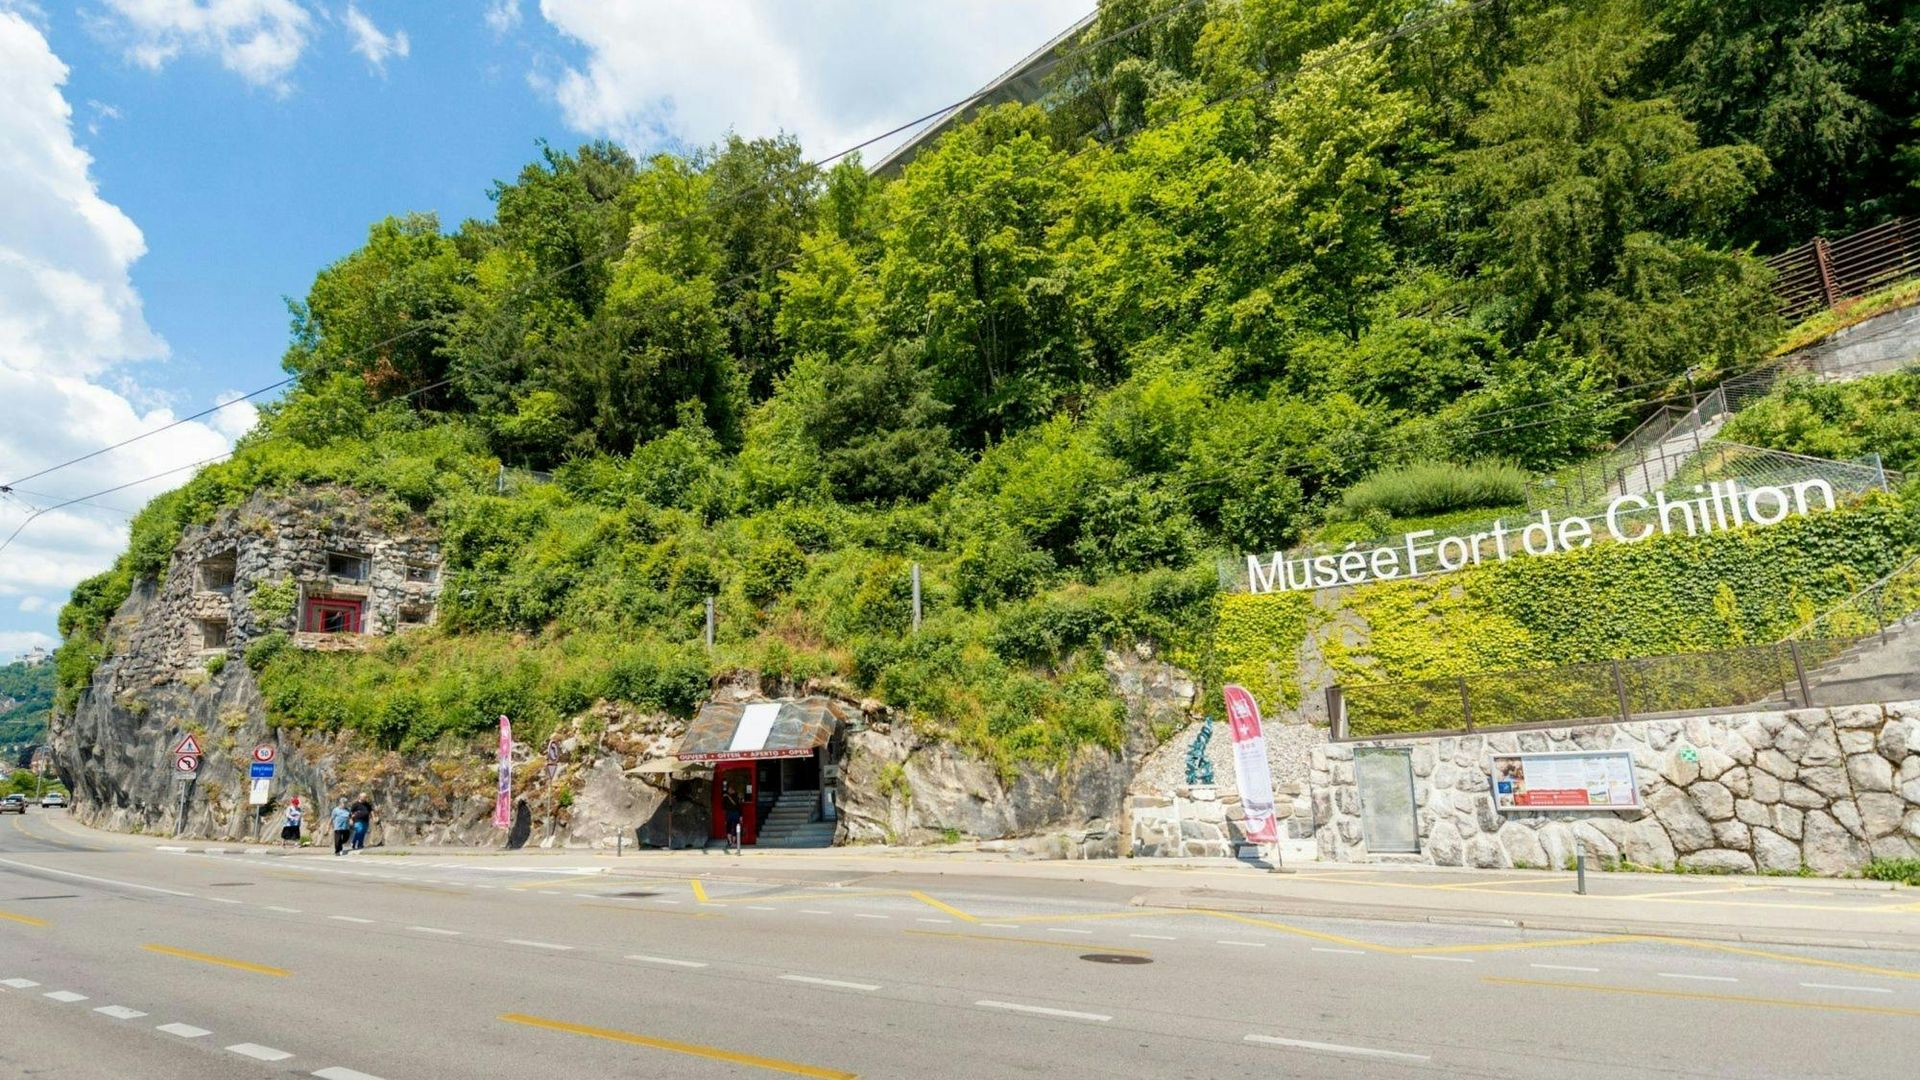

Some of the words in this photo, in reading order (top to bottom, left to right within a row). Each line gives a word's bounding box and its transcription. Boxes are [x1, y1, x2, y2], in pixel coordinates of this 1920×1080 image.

[1247, 542, 1399, 594] Musée
[1405, 519, 1510, 575] Fort
[1522, 509, 1592, 556] de
[1606, 478, 1836, 543] Chillon
